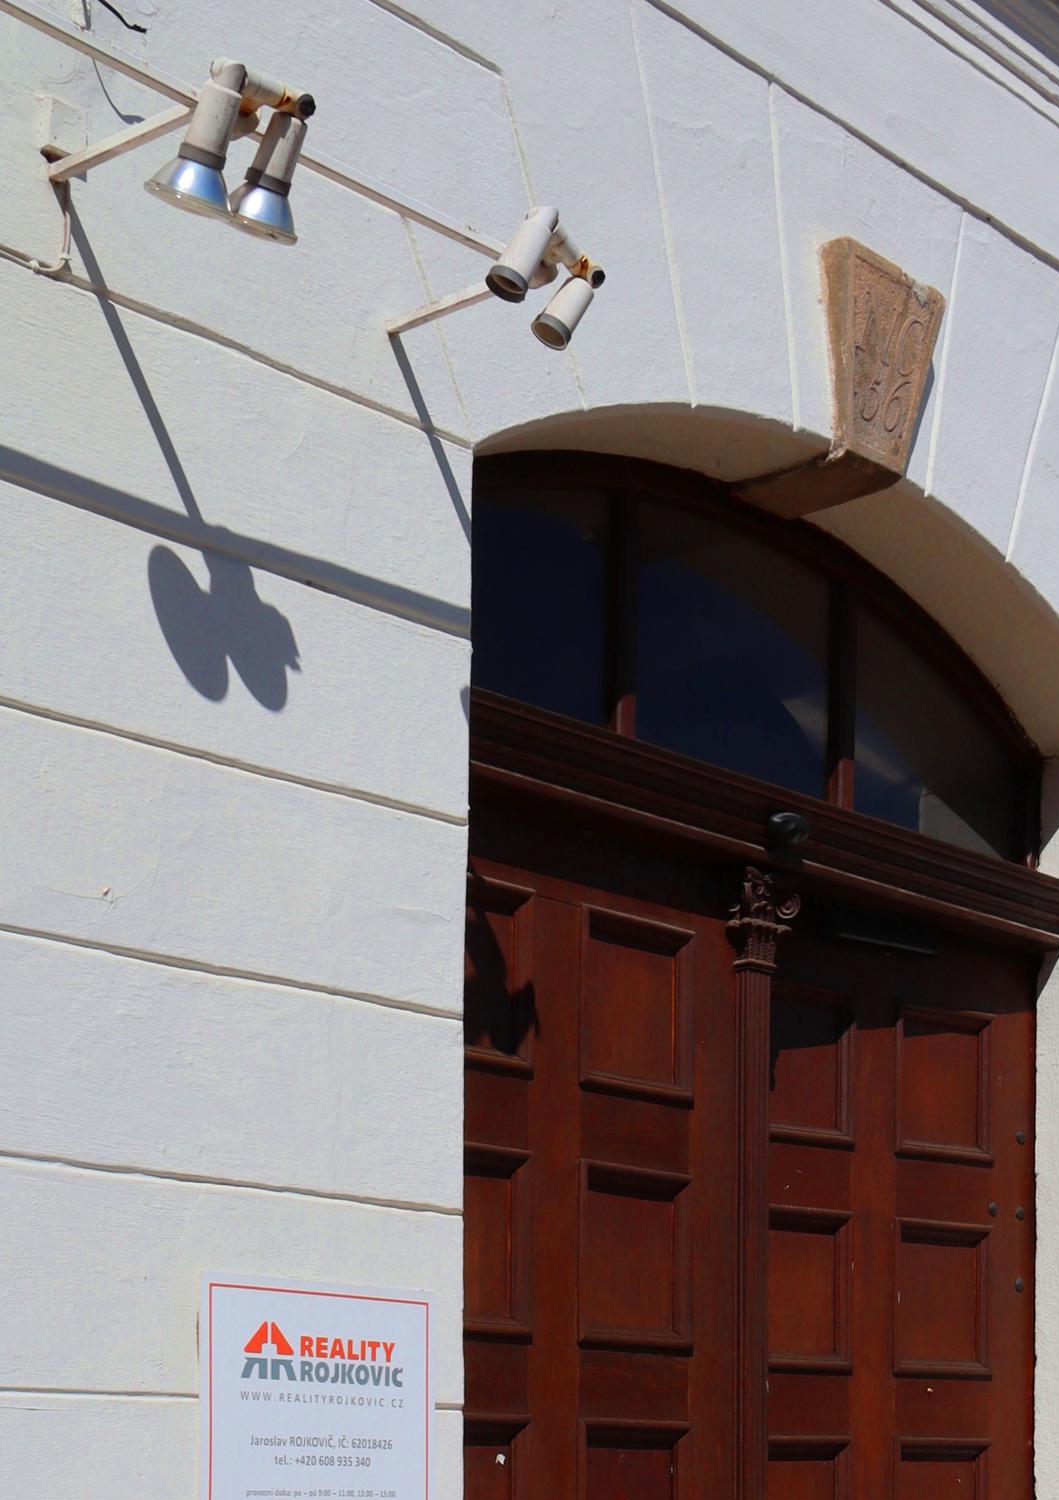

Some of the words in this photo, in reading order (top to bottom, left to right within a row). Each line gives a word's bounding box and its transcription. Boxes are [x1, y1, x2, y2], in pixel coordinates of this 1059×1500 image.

[300, 1335, 395, 1362] REALITY
[240, 1390, 404, 1408] WWW.REALITYROJKOVIC.CZ
[250, 1435, 287, 1447] Jaroslav
[289, 1434, 336, 1450] ROJKOVIČ,
[338, 1435, 350, 1449] IČ:
[351, 1438, 393, 1450] 62018426
[275, 1455, 292, 1466] tel.:
[295, 1455, 317, 1466] +420
[319, 1456, 335, 1466] 608
[337, 1457, 353, 1467] 935
[355, 1457, 371, 1467] 340
